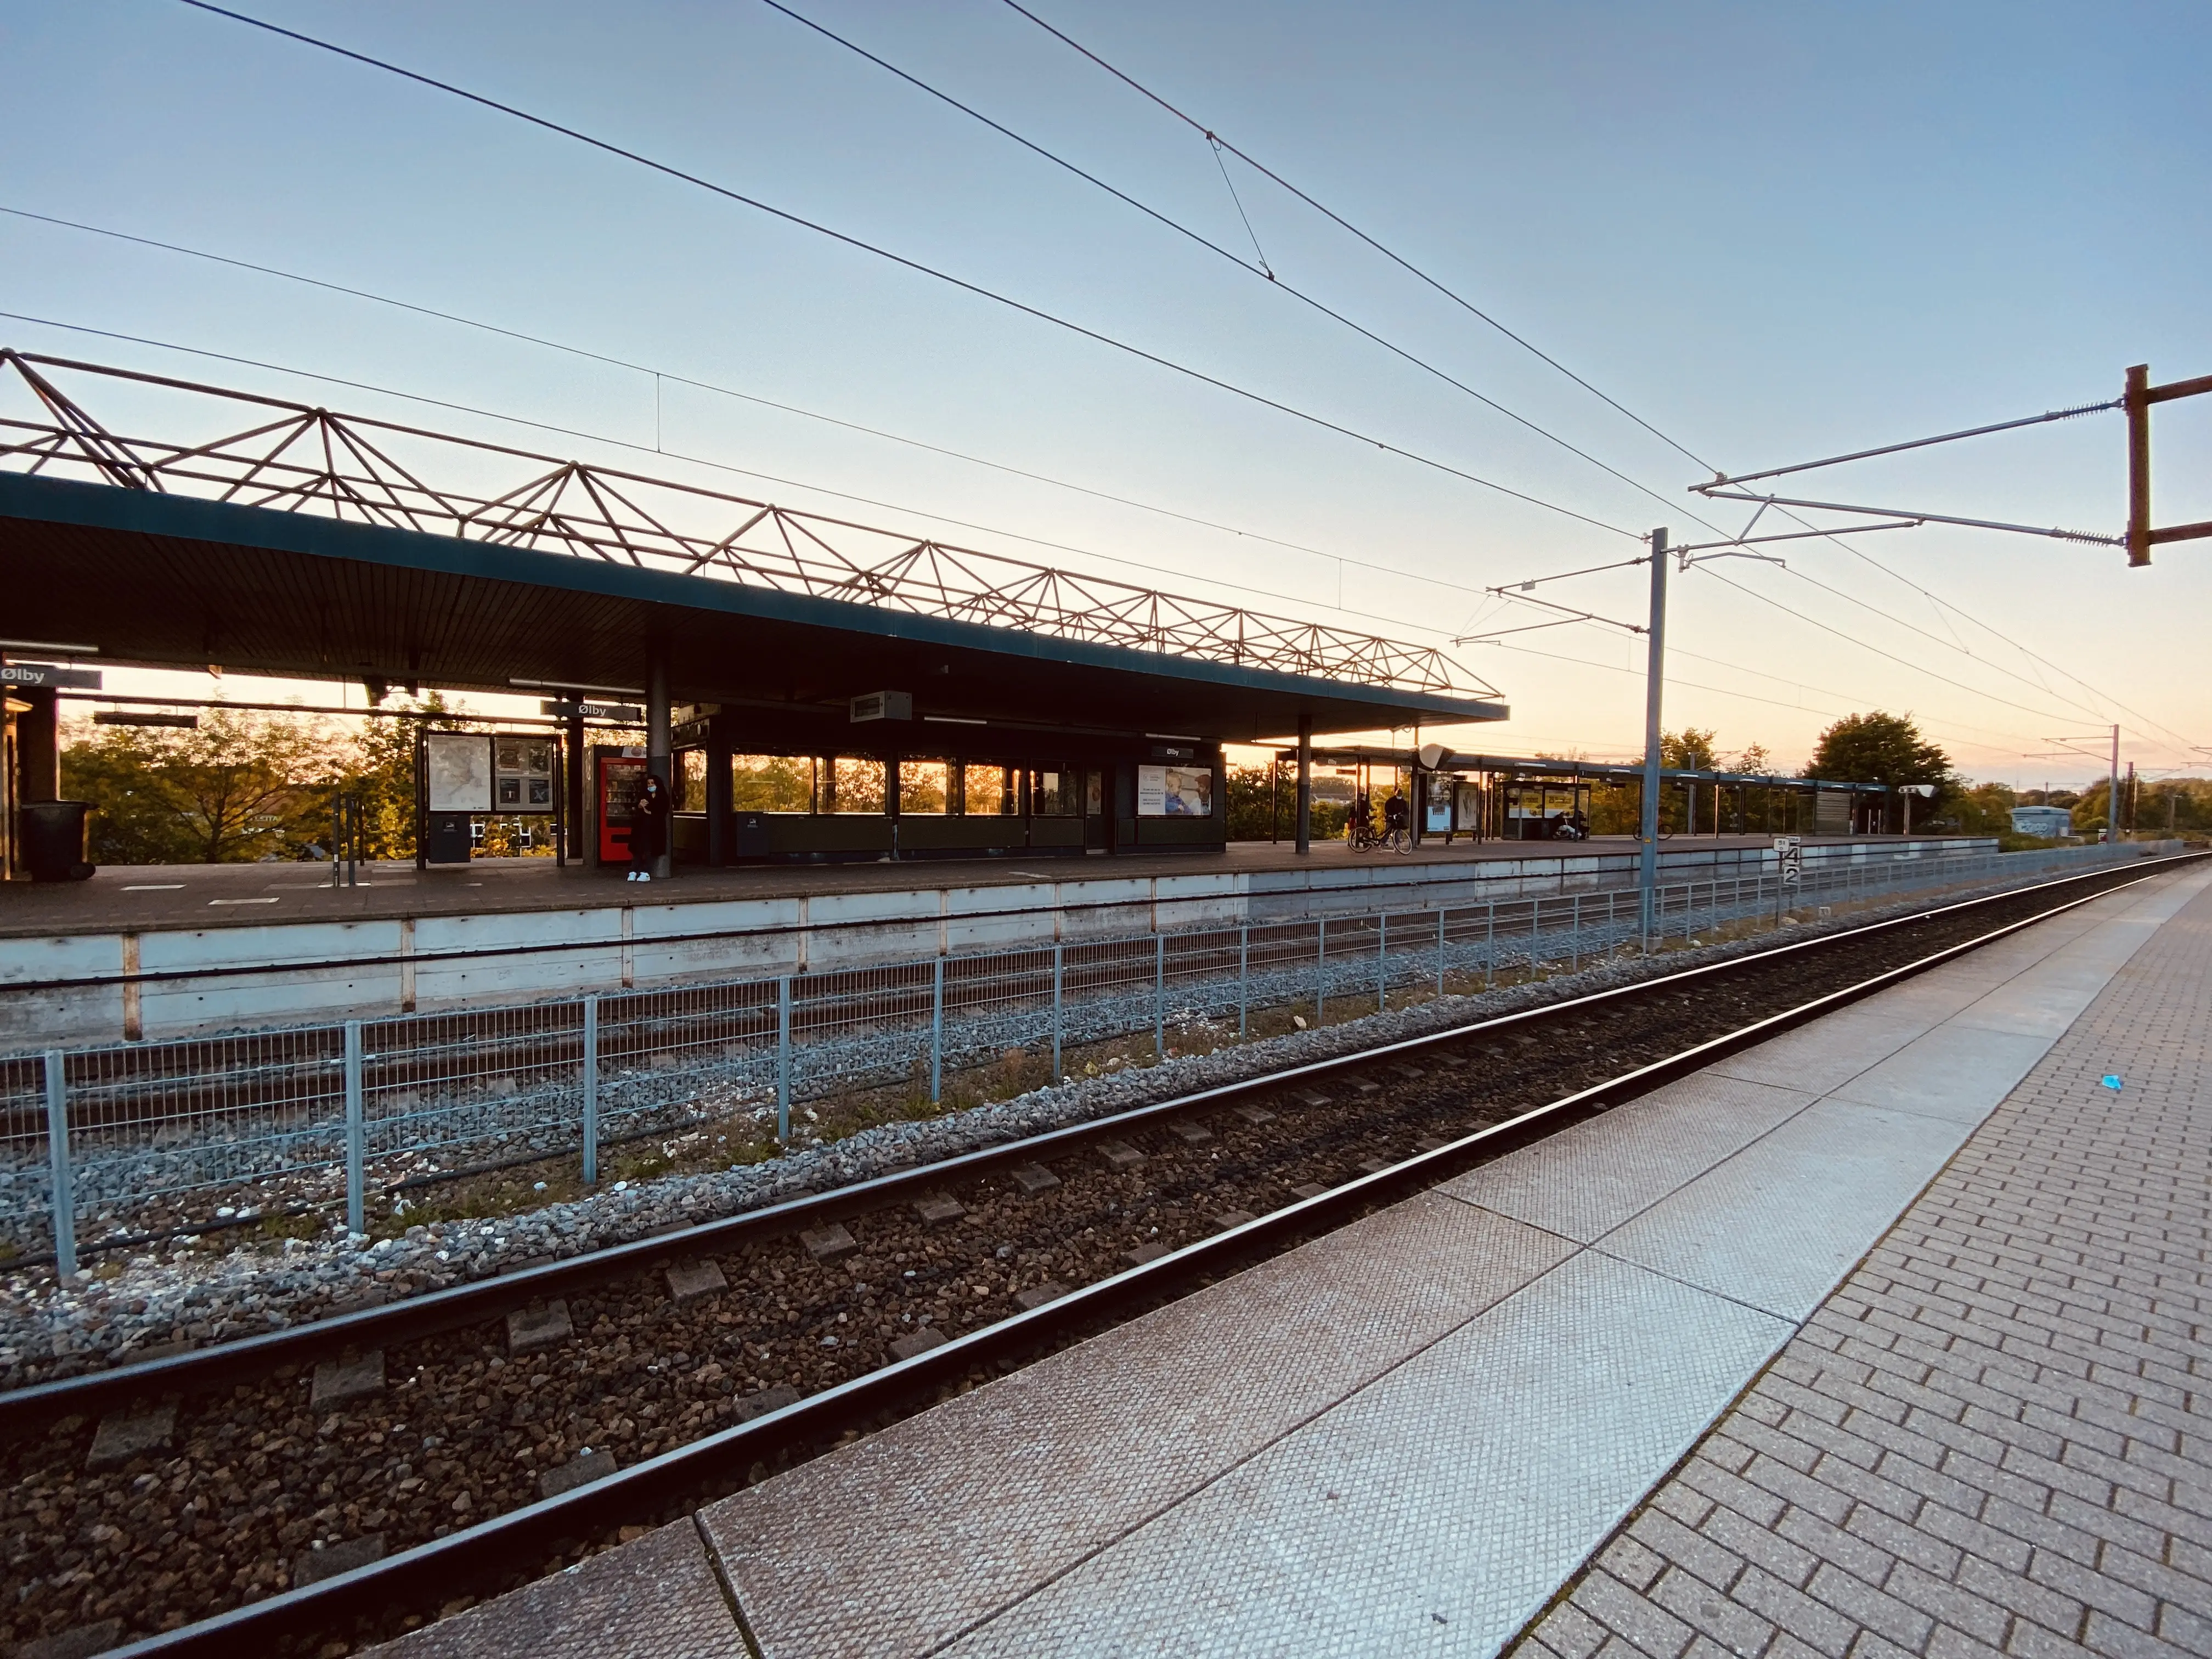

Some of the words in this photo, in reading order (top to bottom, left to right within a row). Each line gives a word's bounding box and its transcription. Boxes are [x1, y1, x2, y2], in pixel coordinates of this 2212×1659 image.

[1, 668, 44, 684] Ølby
[579, 704, 606, 717] Ølby
[1784, 848, 1798, 863] 4
[1785, 868, 1799, 883] 2
